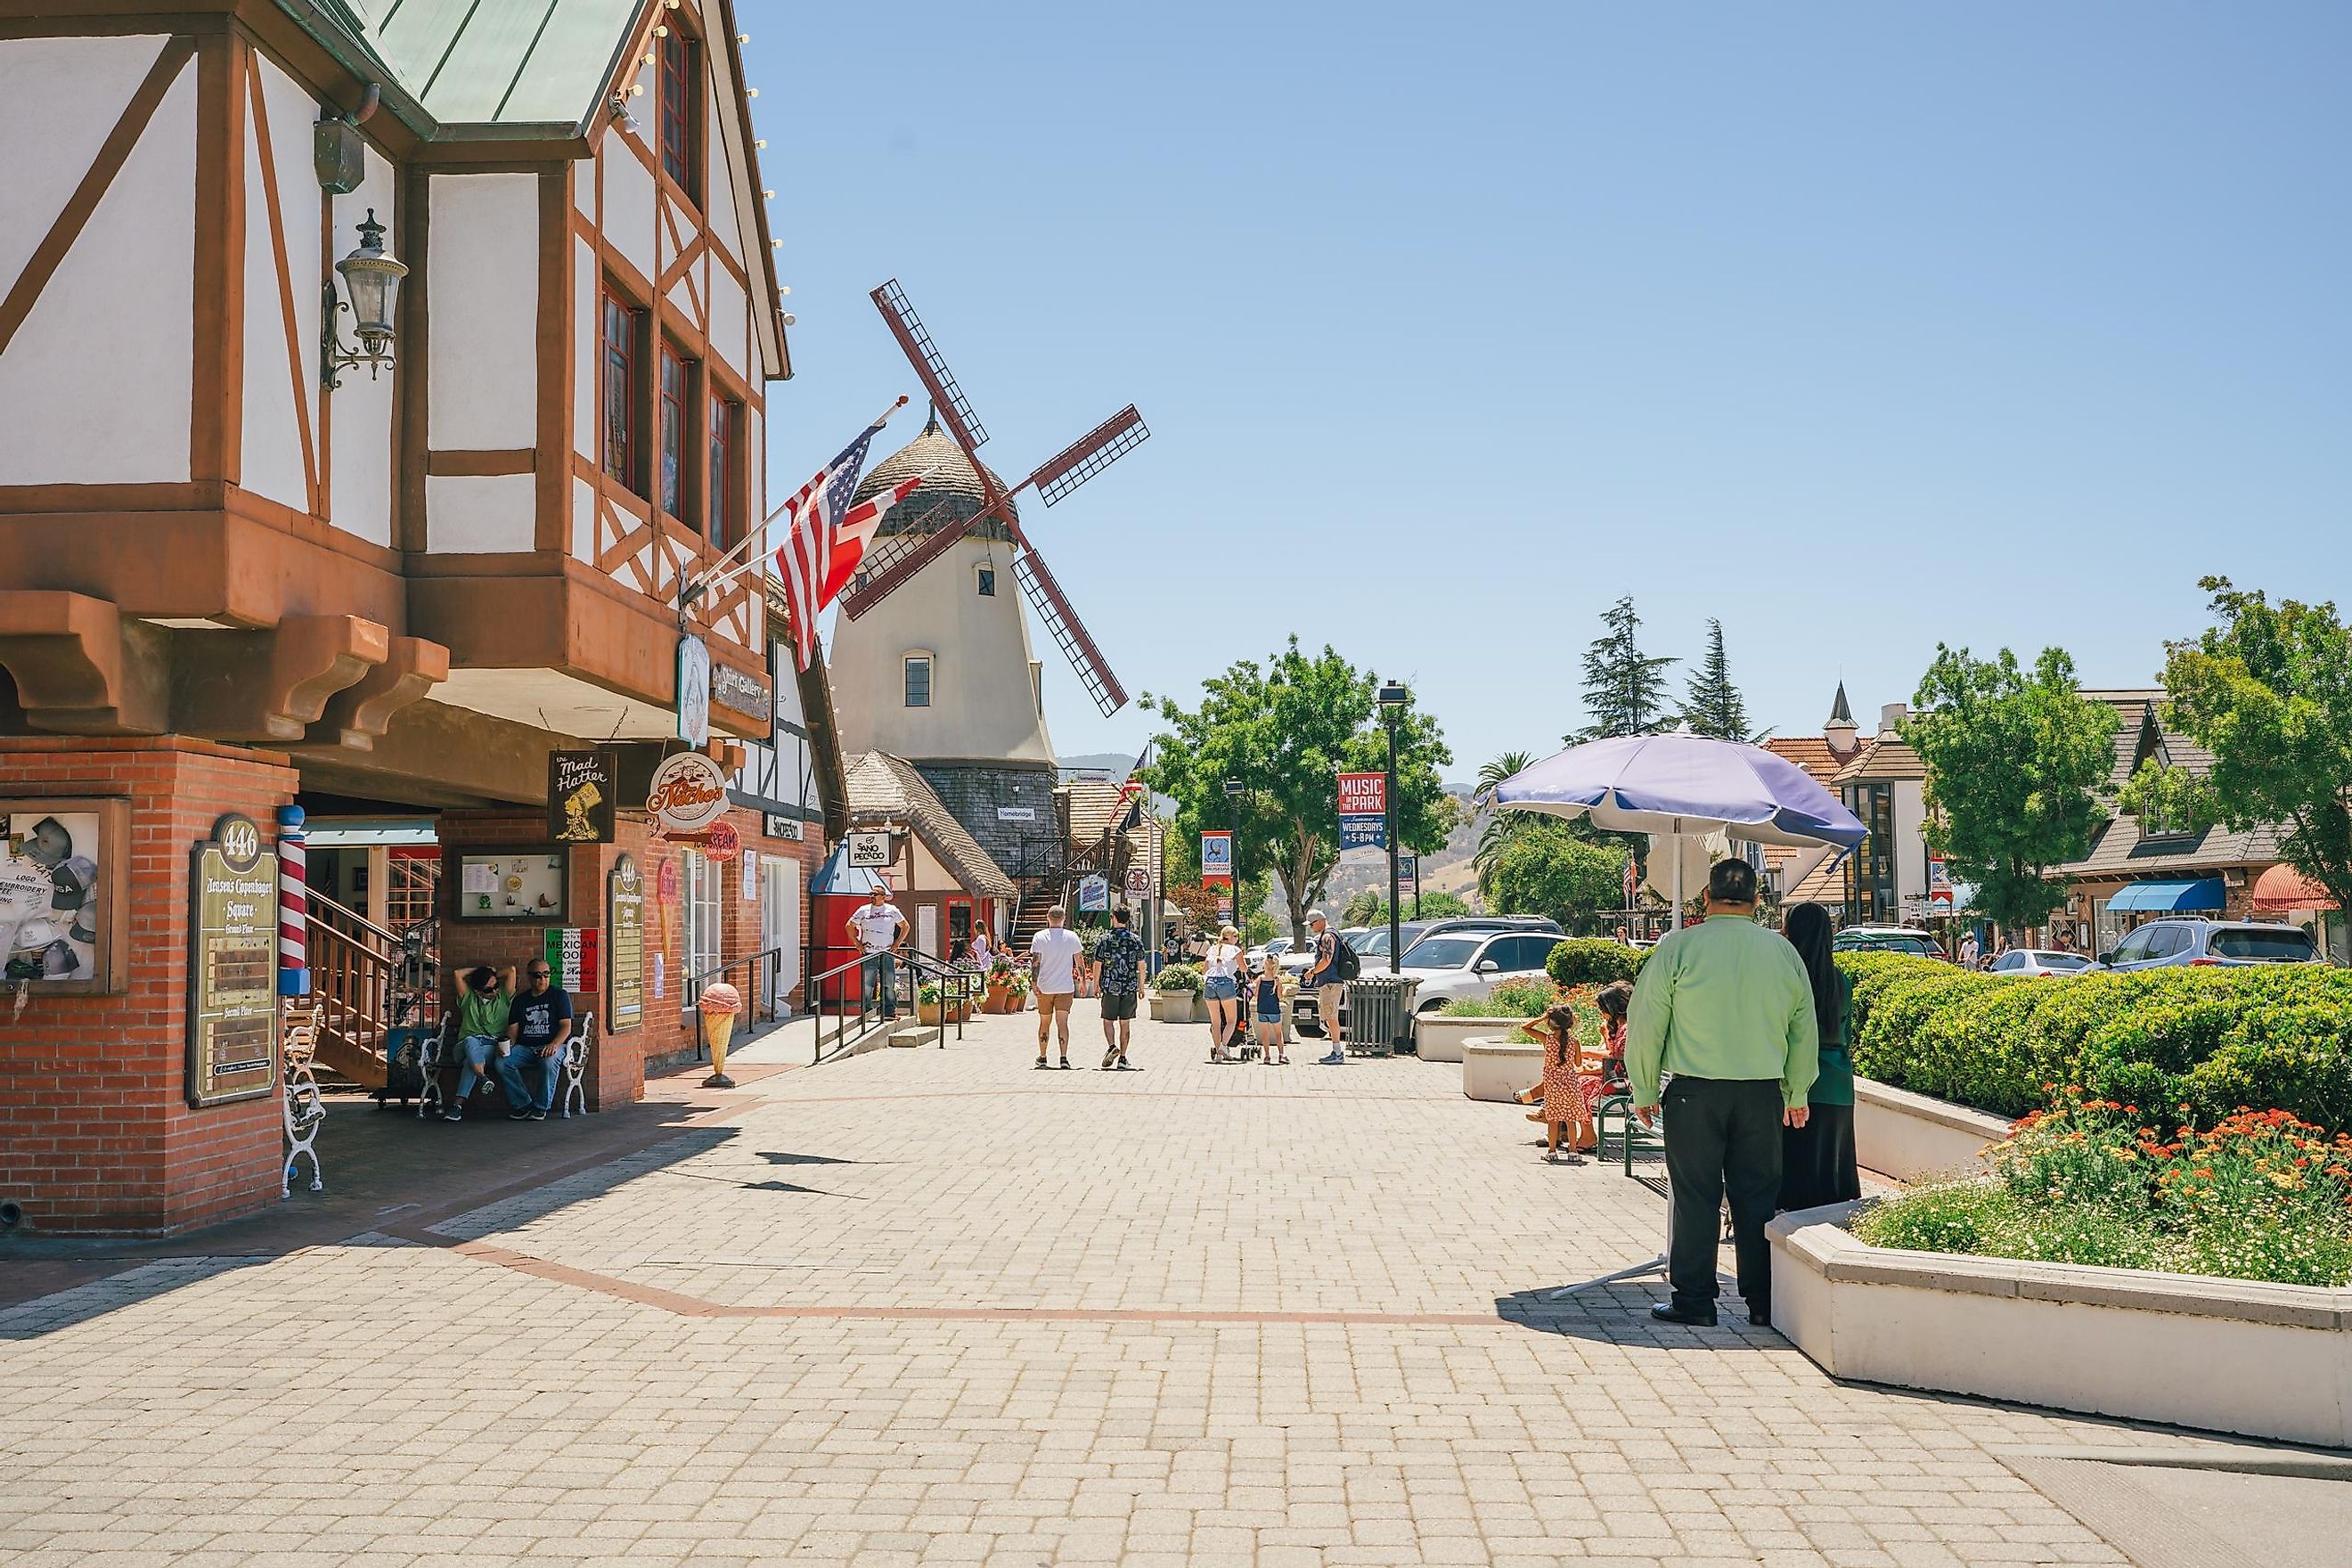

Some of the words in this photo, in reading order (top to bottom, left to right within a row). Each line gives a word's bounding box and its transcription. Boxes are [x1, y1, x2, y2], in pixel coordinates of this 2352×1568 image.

[739, 676, 763, 704] Gallery
[559, 756, 599, 776] Mad
[556, 771, 608, 792] Hatter
[1341, 779, 1383, 796] MUSIC
[1352, 796, 1383, 811] PARK
[1342, 821, 1384, 832] WEDNESDAYS
[225, 825, 257, 857] 446
[856, 843, 879, 853] SANO
[853, 852, 886, 861] PECADO
[235, 878, 274, 898] Copenhagen
[226, 900, 254, 920] Square
[546, 940, 597, 949] MEXICAN
[556, 951, 587, 960] FOOD
